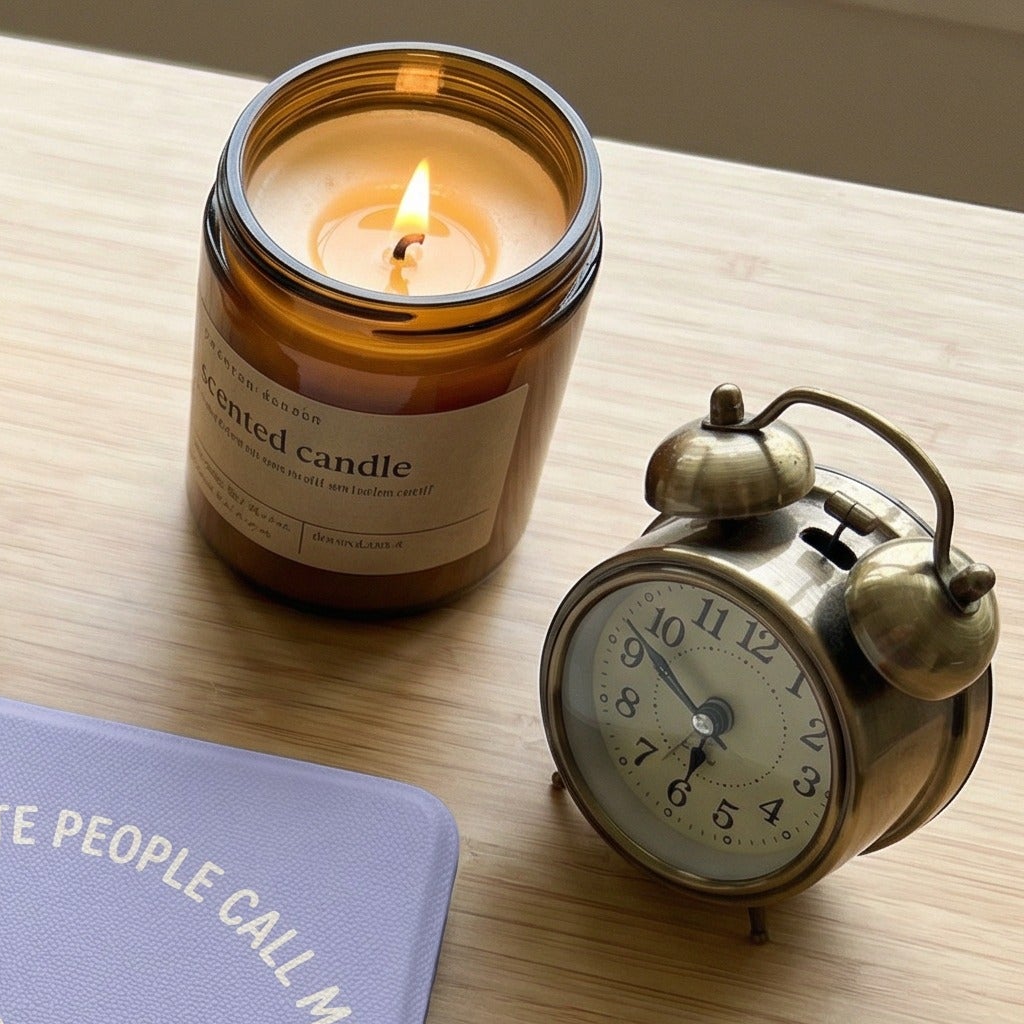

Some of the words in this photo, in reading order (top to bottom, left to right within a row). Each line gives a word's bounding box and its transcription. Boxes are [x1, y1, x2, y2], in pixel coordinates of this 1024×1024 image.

[200, 363, 288, 454] scented
[296, 442, 414, 479] candle
[644, 607, 687, 648] 10
[691, 597, 730, 642] 11
[620, 636, 646, 669] 9
[736, 619, 781, 665] 12
[785, 670, 808, 699] 1
[615, 686, 640, 719] 8
[633, 736, 659, 768] 7
[799, 718, 827, 753] 2
[666, 778, 692, 809] 6
[792, 765, 822, 798] 3
[712, 798, 740, 830] 5
[758, 797, 785, 828] 4
[51, 807, 225, 904] PEOPLE
[218, 888, 316, 988] CALL
